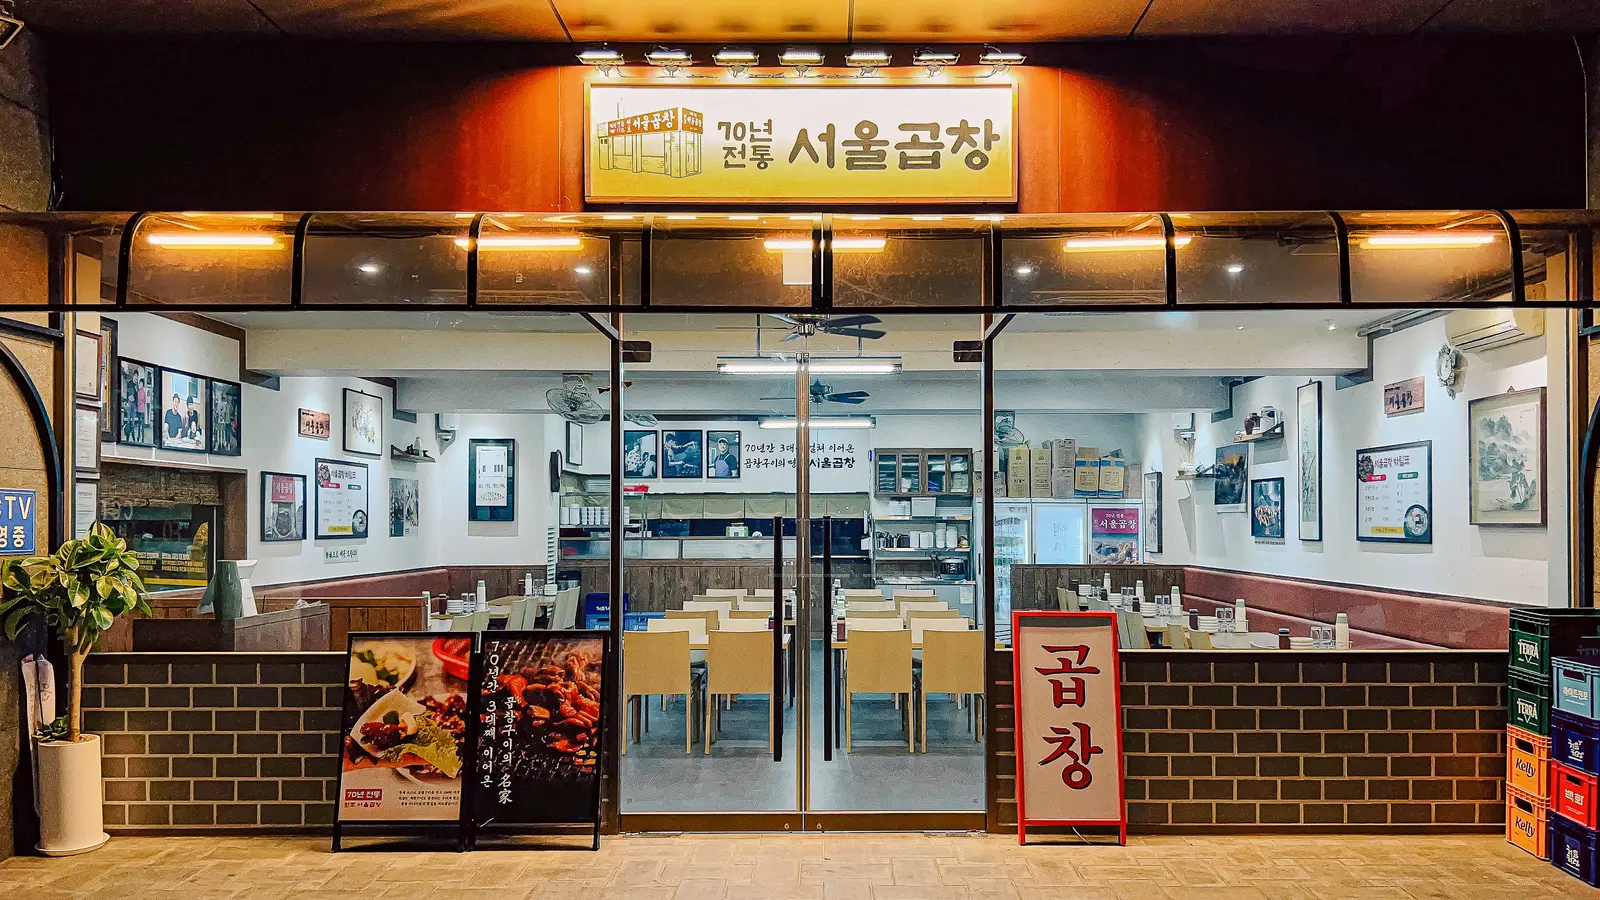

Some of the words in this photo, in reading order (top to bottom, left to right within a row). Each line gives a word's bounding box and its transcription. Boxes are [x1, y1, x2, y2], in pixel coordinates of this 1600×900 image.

[633, 109, 675, 131] 서울곱창
[718, 119, 772, 142] 70년
[723, 143, 774, 170] 전통
[788, 119, 1001, 171] 서울곱창
[744, 443, 775, 454] 70년간
[828, 443, 855, 454] 이어온
[744, 457, 785, 469] 곱창구이의
[809, 456, 856, 469] 서울곱창
[0, 496, 31, 520] TV
[1100, 519, 1137, 530] 서울곱창
[1518, 639, 1539, 660] TERRA
[486, 640, 500, 693] 70년간
[483, 700, 497, 740] 3대째
[1034, 644, 1104, 790] 곱창
[1517, 698, 1538, 720] TERRA
[501, 696, 517, 767] 곱창구이의
[480, 746, 494, 788] 이어온
[1516, 757, 1536, 778] Kelly
[347, 791, 364, 799] 70년
[498, 773, 513, 805] 名家
[1515, 816, 1535, 838] Kelly
